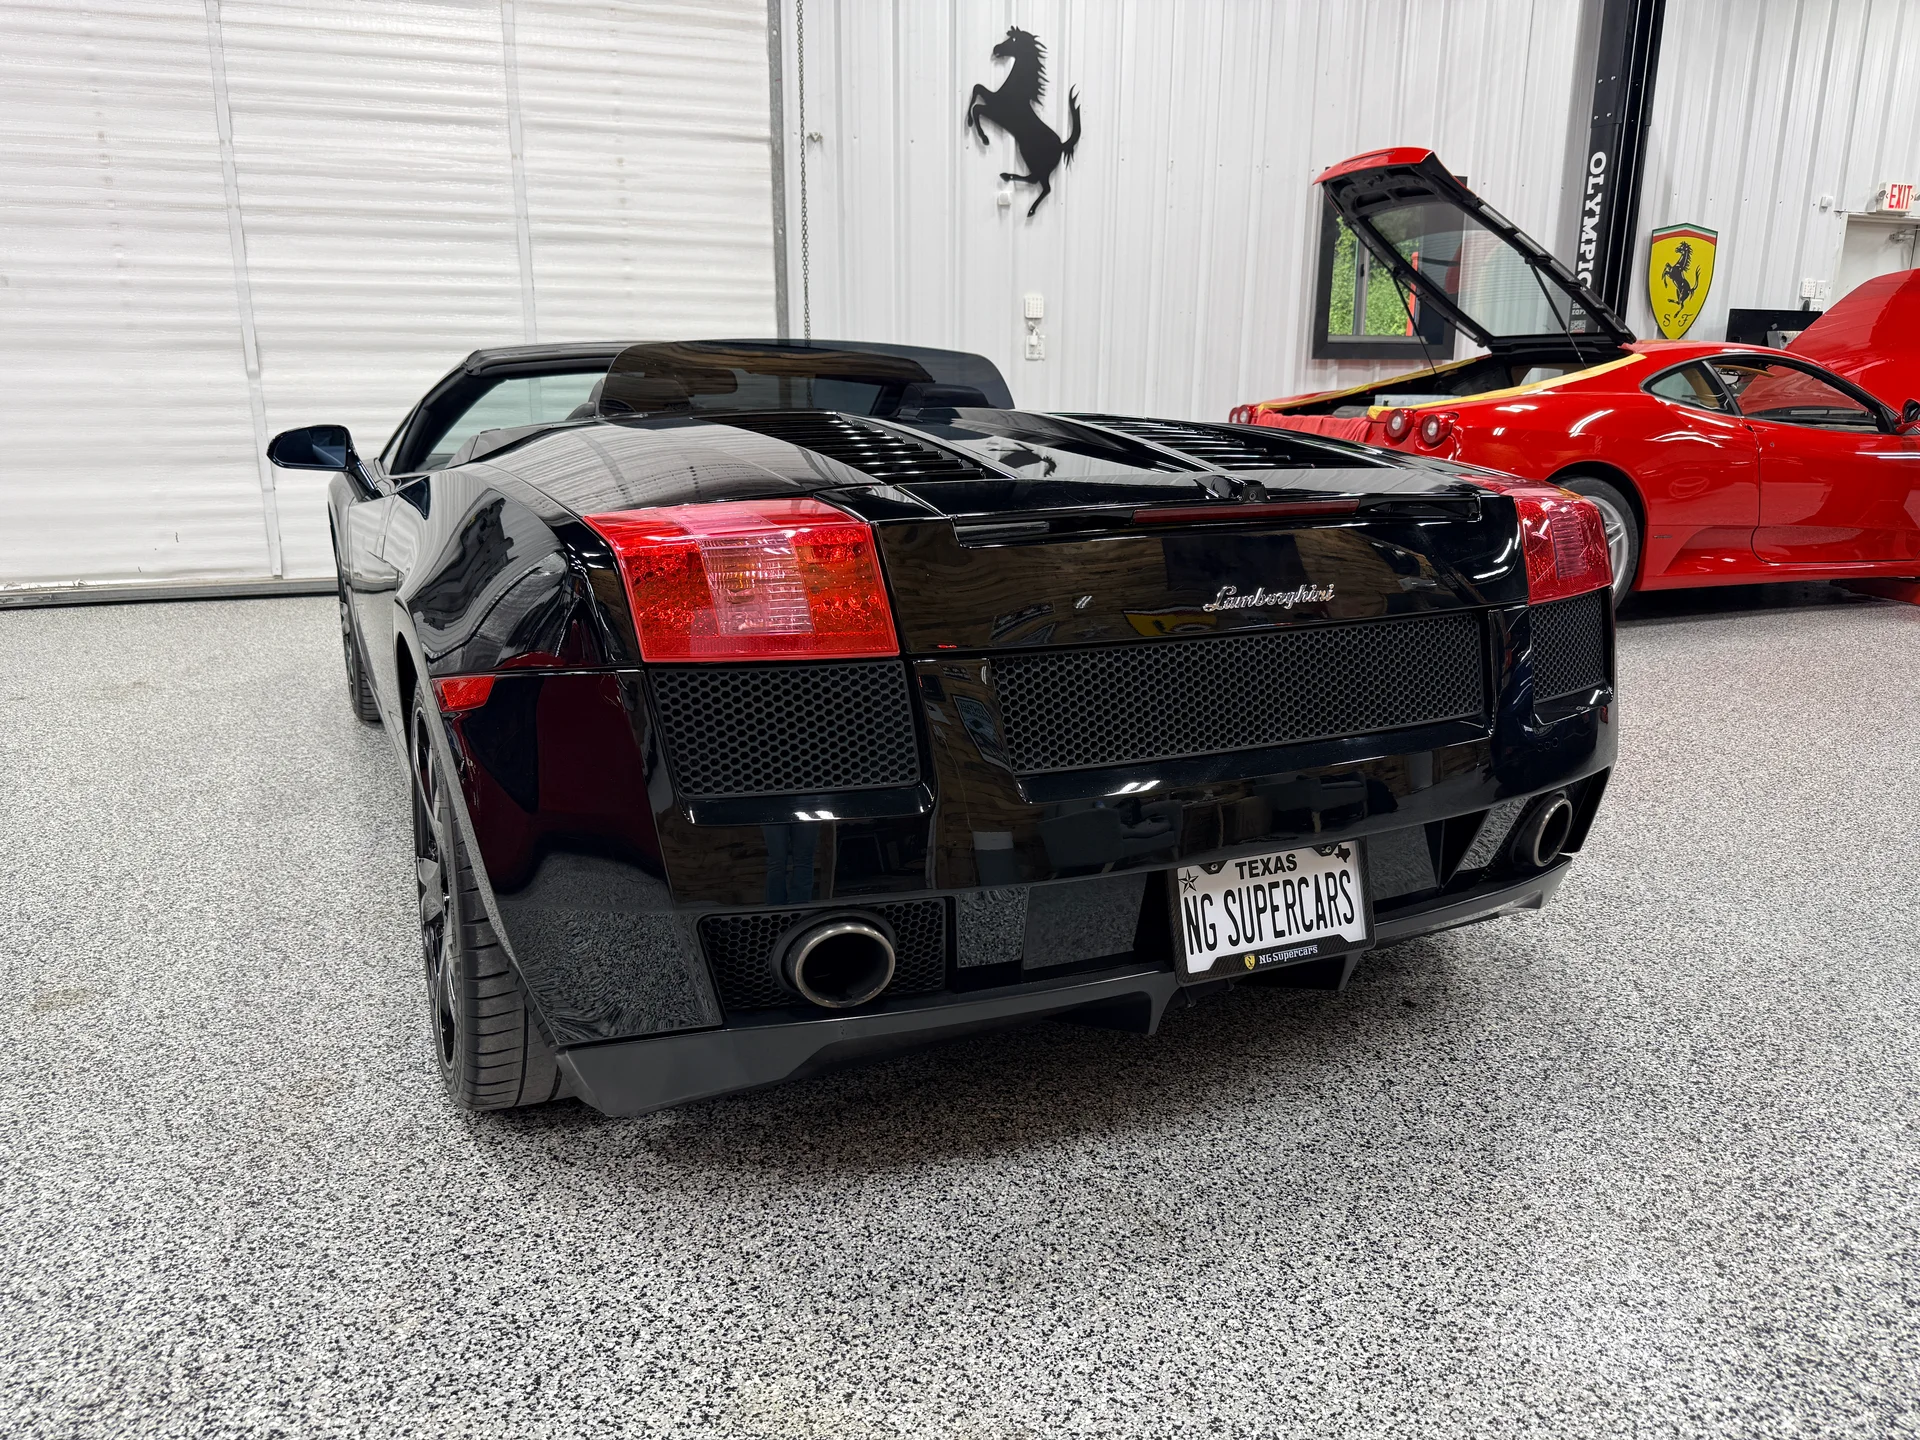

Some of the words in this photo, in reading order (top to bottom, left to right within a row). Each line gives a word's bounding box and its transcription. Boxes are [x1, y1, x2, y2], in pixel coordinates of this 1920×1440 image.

[1888, 184, 1913, 209] EXIT
[1663, 313, 1671, 327] S
[1202, 584, 1335, 612] Lamborghini
[1235, 853, 1298, 880] TEXAS
[1184, 893, 1218, 955] NG
[1223, 869, 1355, 947] SUPERCARS
[1259, 954, 1271, 964] NG
[1272, 945, 1318, 962] Supercars
